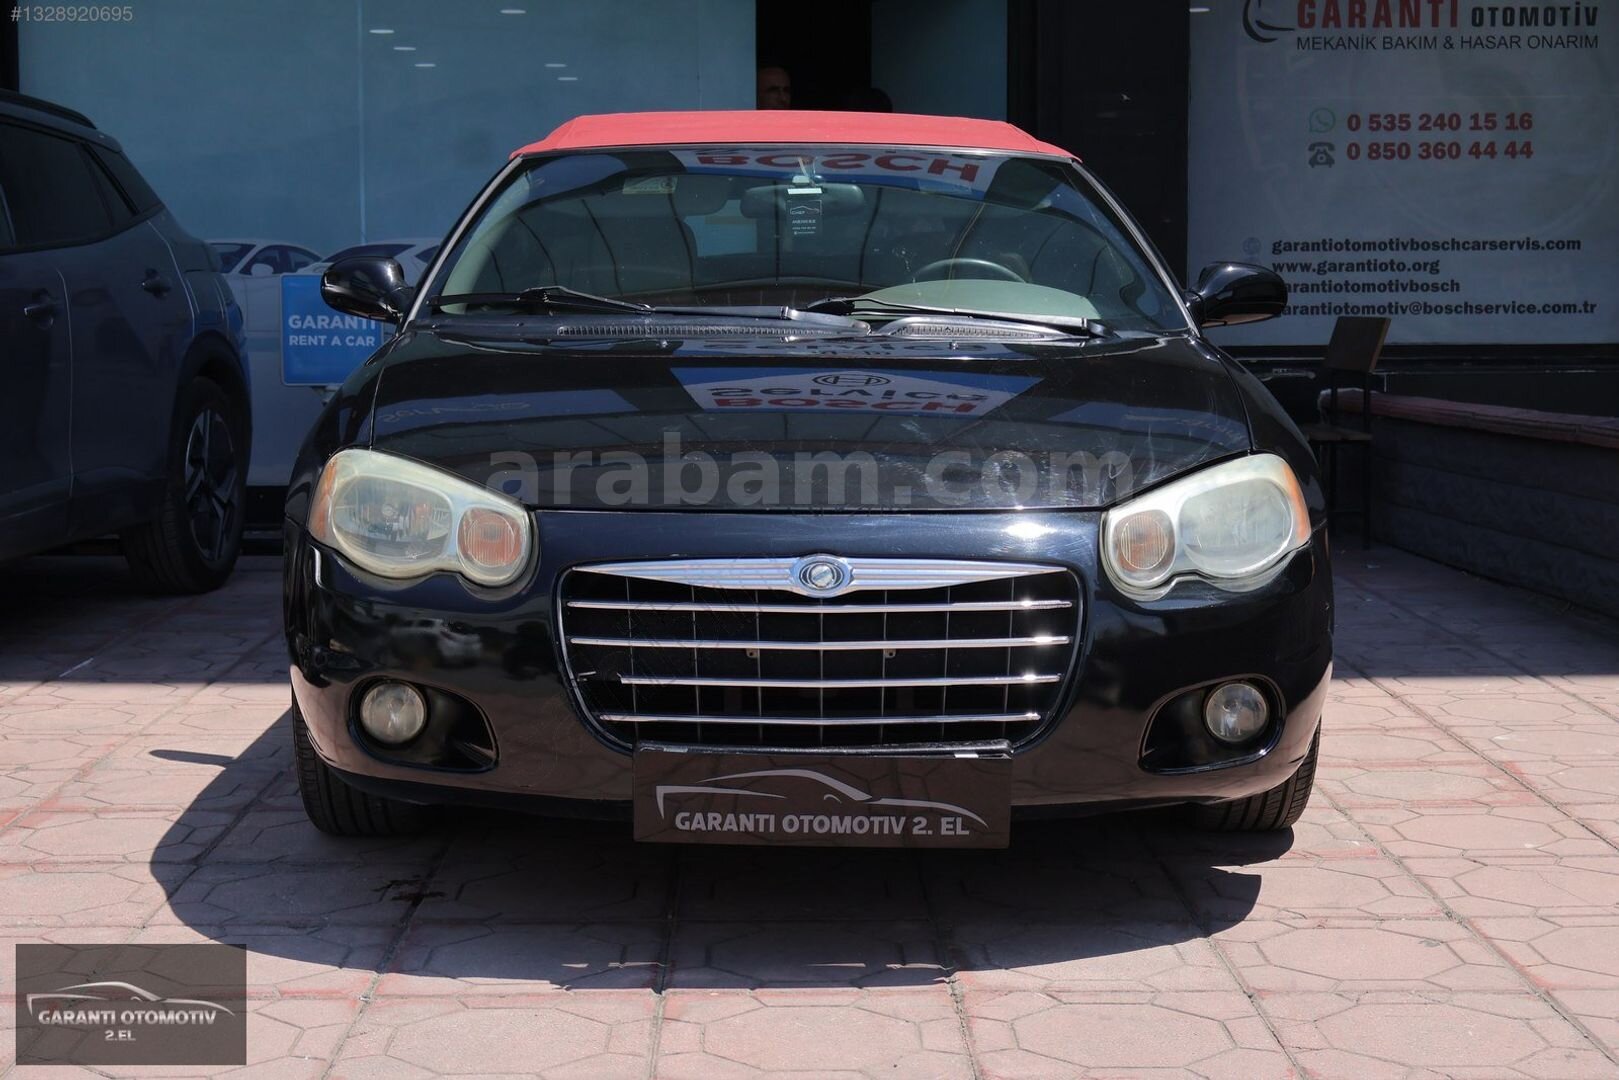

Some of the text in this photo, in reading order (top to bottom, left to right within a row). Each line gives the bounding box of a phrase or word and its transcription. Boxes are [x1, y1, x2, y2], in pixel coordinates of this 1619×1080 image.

[1471, 1, 1598, 27] OTOMOTİV
[1297, 34, 1598, 50] MEKANİK BAKIM & HASAR ONARIM
[1347, 113, 1533, 131] 0 535 240 15 16
[1347, 141, 1533, 160] 0 850 360 44 44
[1272, 237, 1581, 255] garantiotomotivboschcarservis.com
[1272, 259, 1440, 275] www.garantioto.org
[1285, 279, 1460, 294] arantiotomotivbosch
[1282, 300, 1597, 317] arantiotomotiv@boschservice.com.tr
[289, 335, 375, 346] RENT A CAR
[675, 812, 970, 835] GARANTI OTOMOTIV 2. EL
